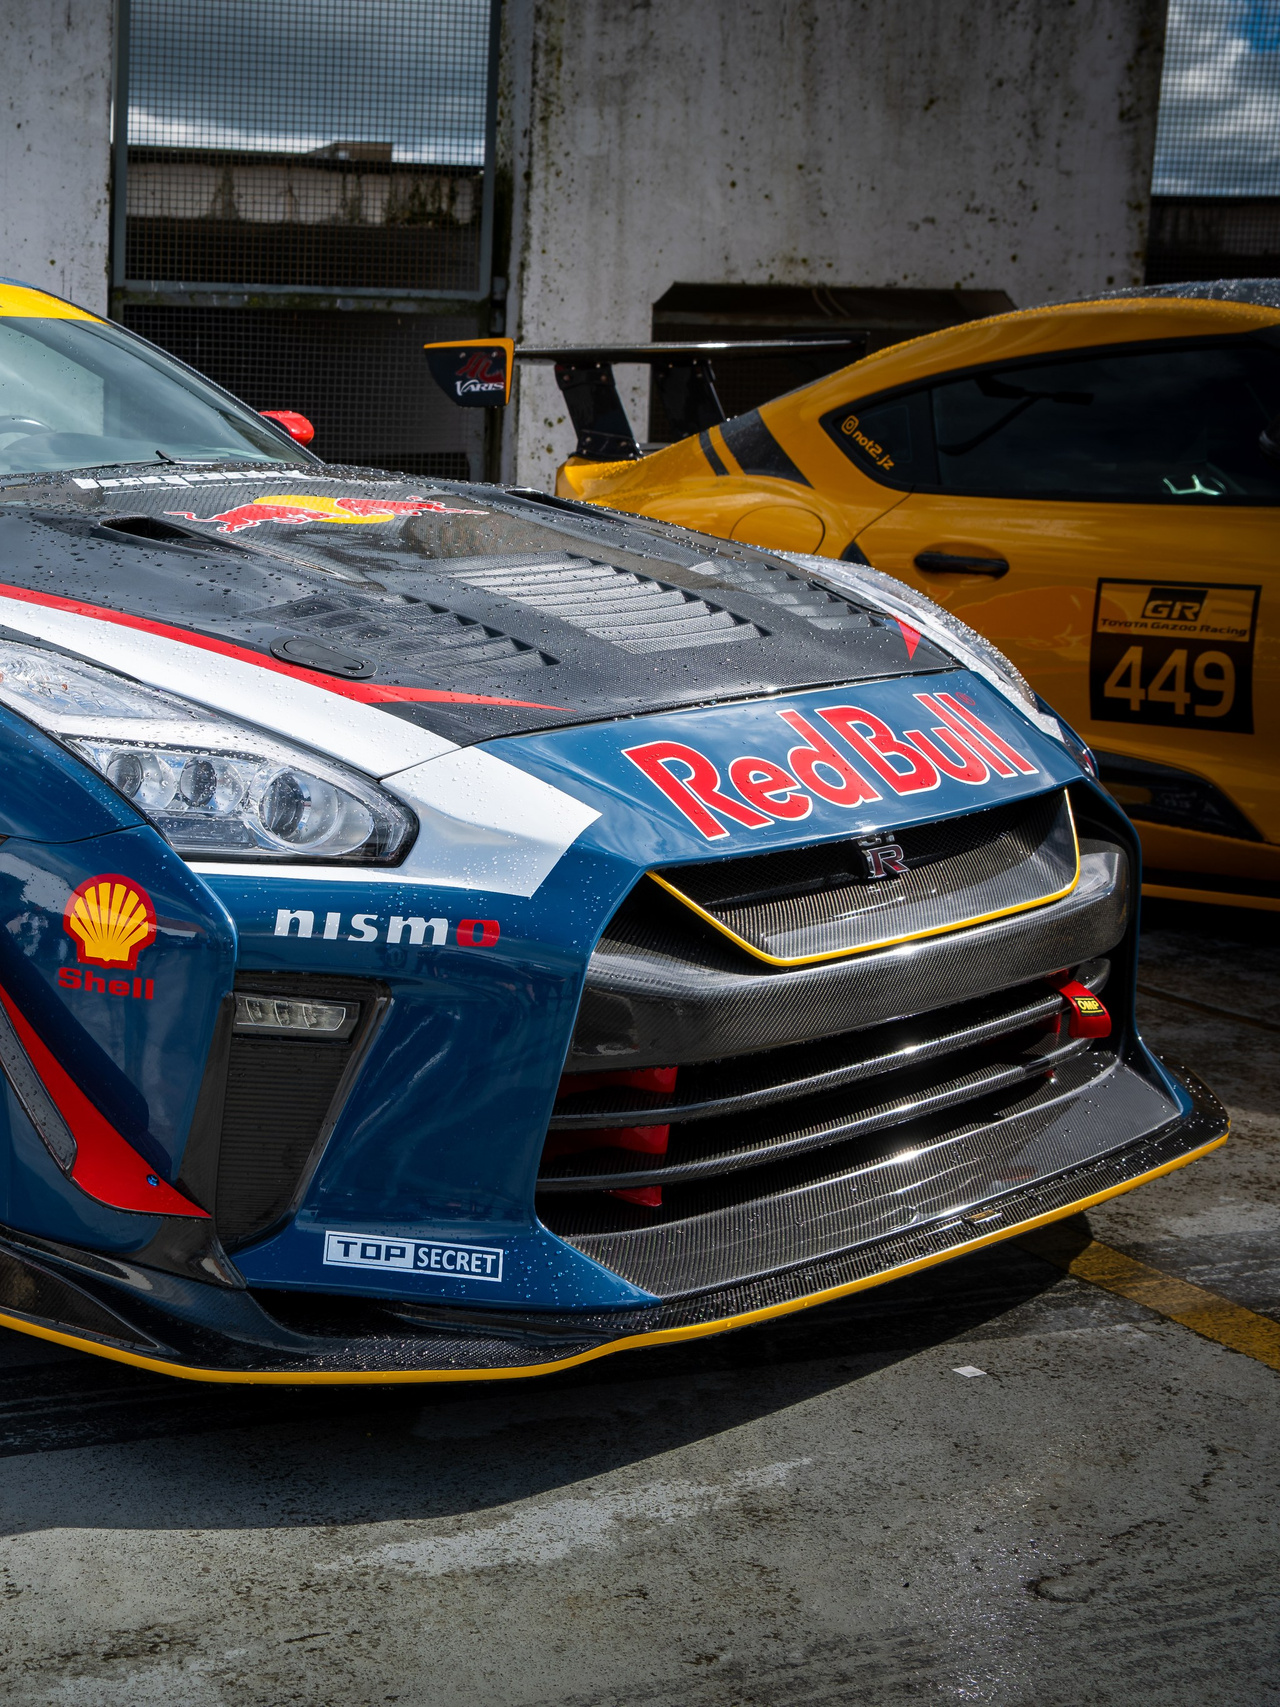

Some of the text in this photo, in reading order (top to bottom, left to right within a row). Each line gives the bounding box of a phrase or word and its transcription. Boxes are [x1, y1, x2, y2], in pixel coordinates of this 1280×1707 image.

[1144, 600, 1201, 621] GR
[1200, 625, 1248, 637] Racing
[1103, 645, 1236, 718] 449
[274, 908, 501, 947] nismo
[58, 966, 154, 1000] Shell
[1077, 1000, 1100, 1011] OMP
[337, 1239, 498, 1274] TOP SECRET
